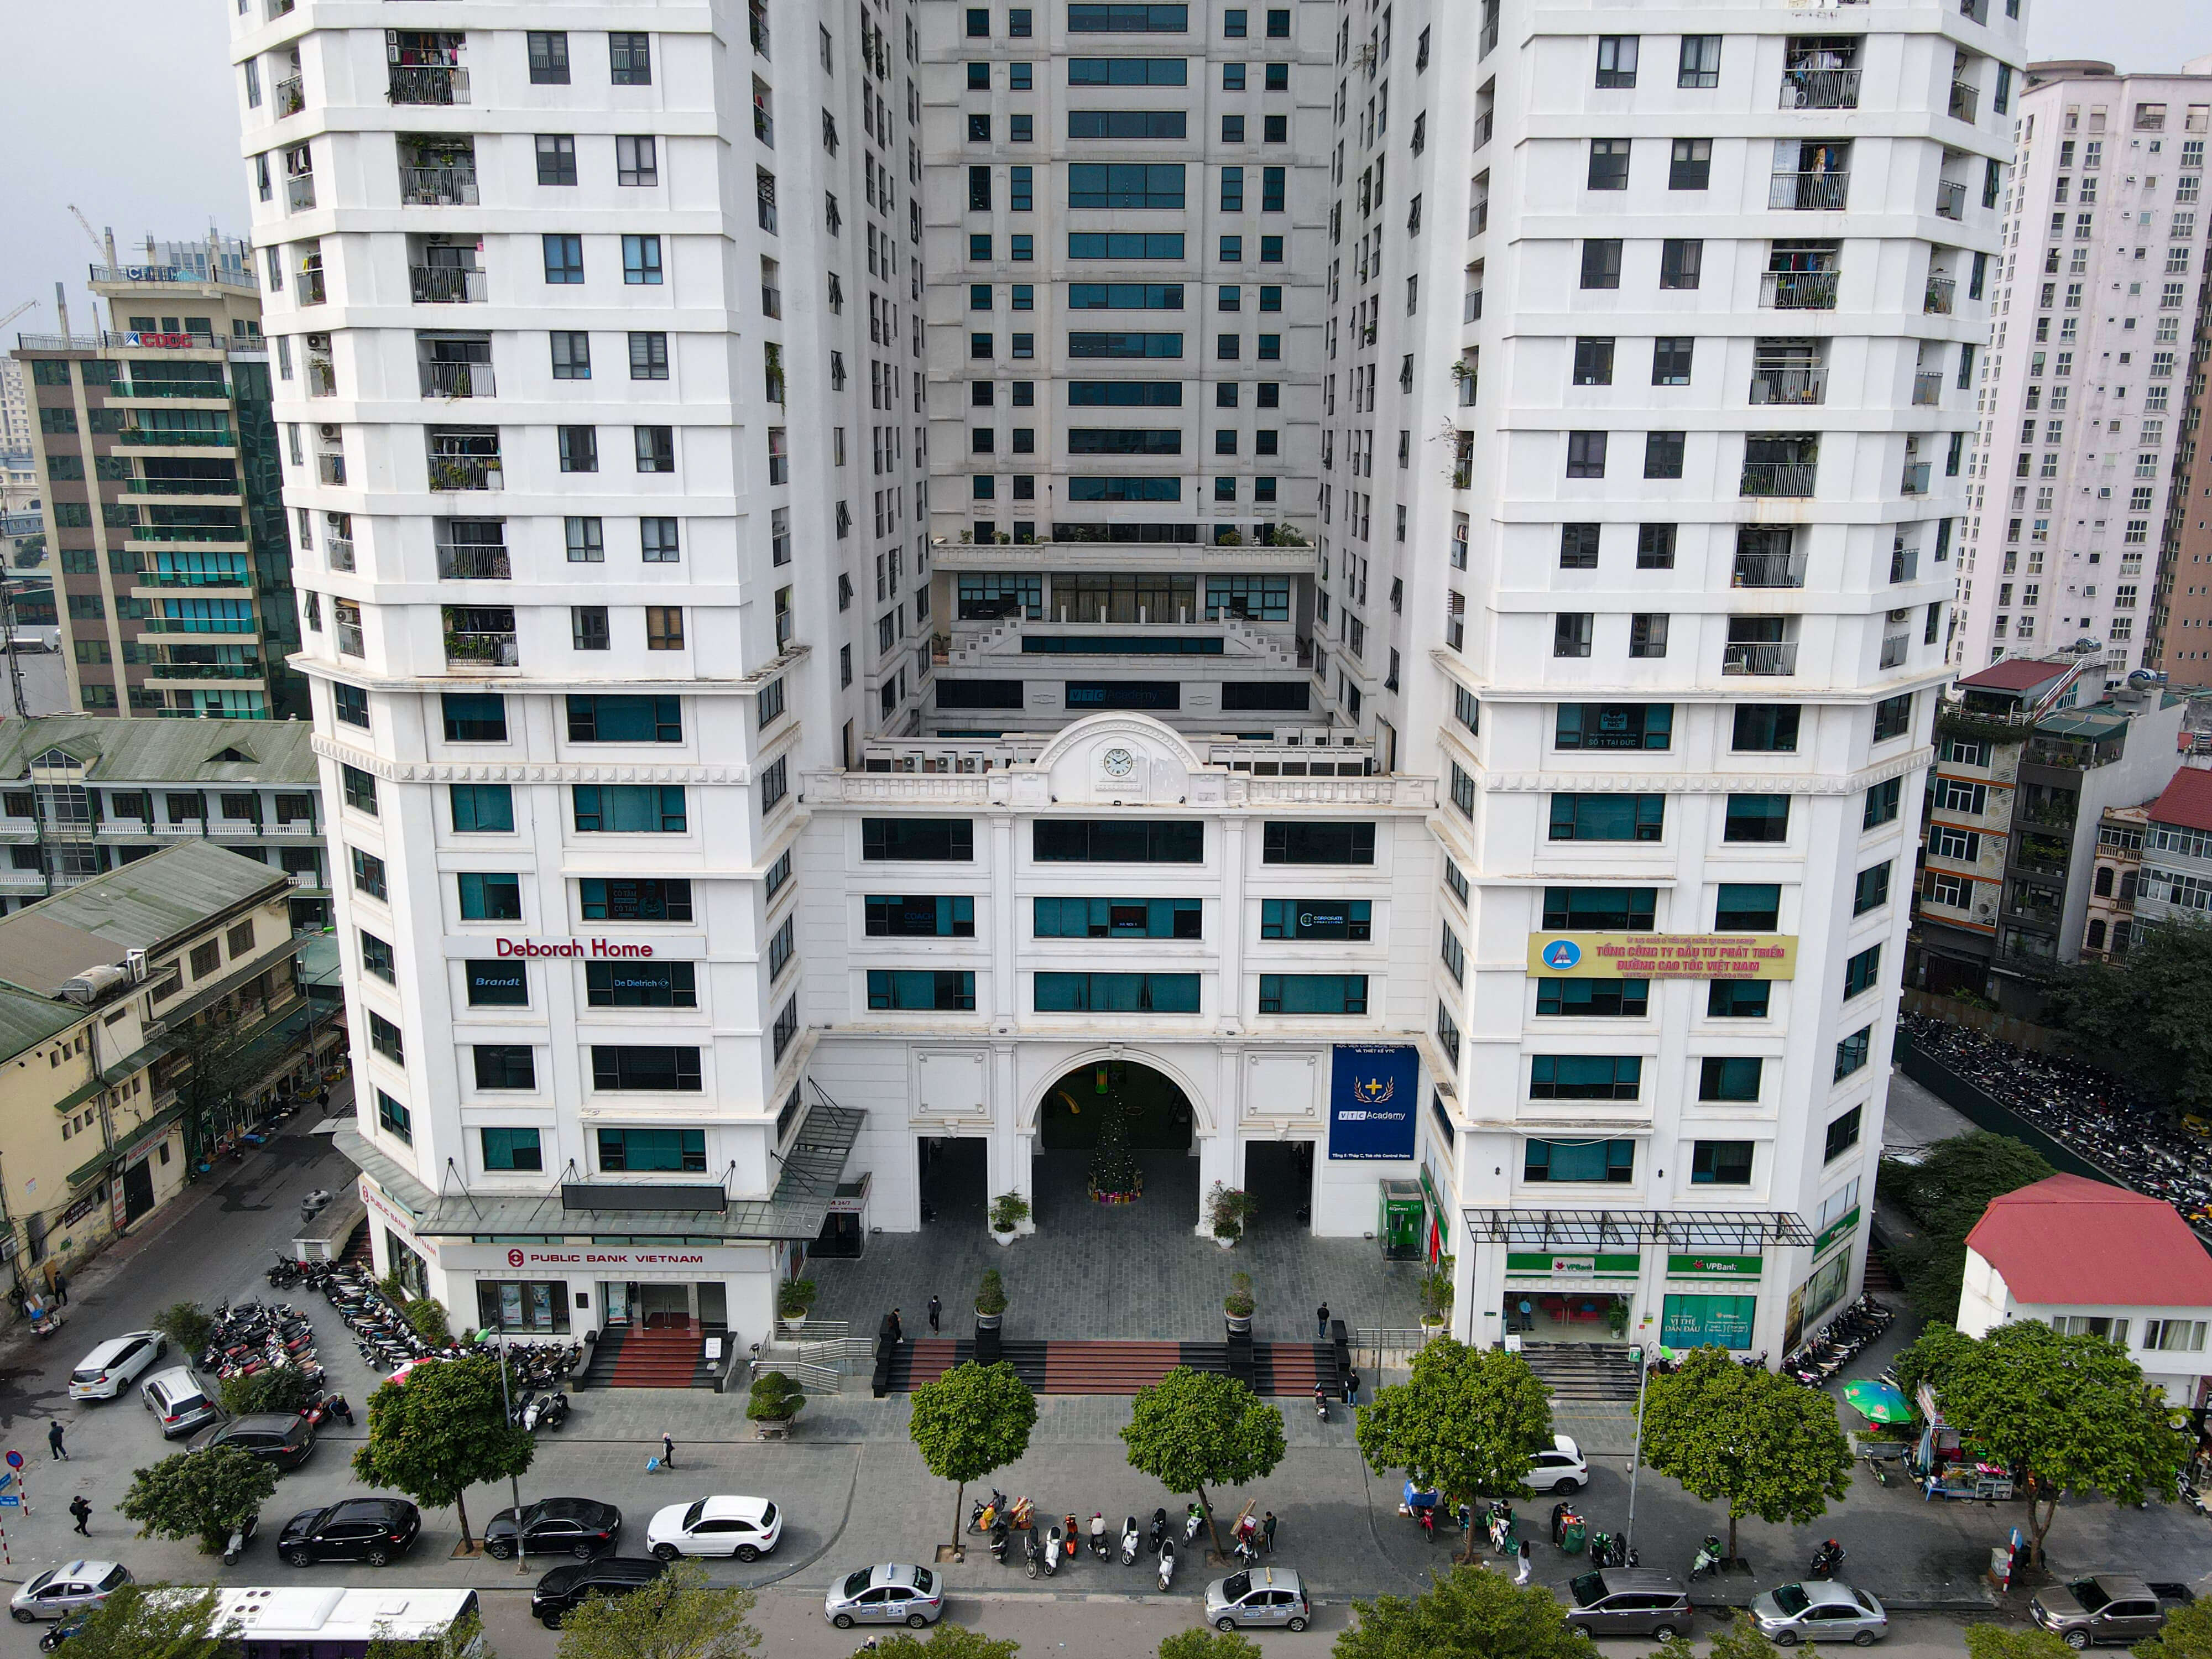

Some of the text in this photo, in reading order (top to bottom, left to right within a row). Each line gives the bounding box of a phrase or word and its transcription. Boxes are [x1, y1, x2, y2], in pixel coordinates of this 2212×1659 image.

[142, 333, 193, 348] CDCC
[1107, 690, 1159, 702] Academy
[495, 938, 653, 957] Deborah Home
[1597, 942, 1625, 957] TỔNG
[1628, 945, 1658, 957] CÔNG
[1661, 947, 1674, 957] TY
[1703, 947, 1718, 957] TƯ
[1719, 946, 1749, 957] PHÁT
[1752, 944, 1785, 958] TRIỂN
[1658, 961, 1680, 971] CAO
[1682, 957, 1704, 971] TỐC
[1707, 959, 1731, 973] VIỆT
[1733, 961, 1760, 971] NAM
[475, 978, 520, 986] Brandt
[1339, 1111, 1406, 1120] VTC Academy
[390, 1212, 408, 1232] BANK
